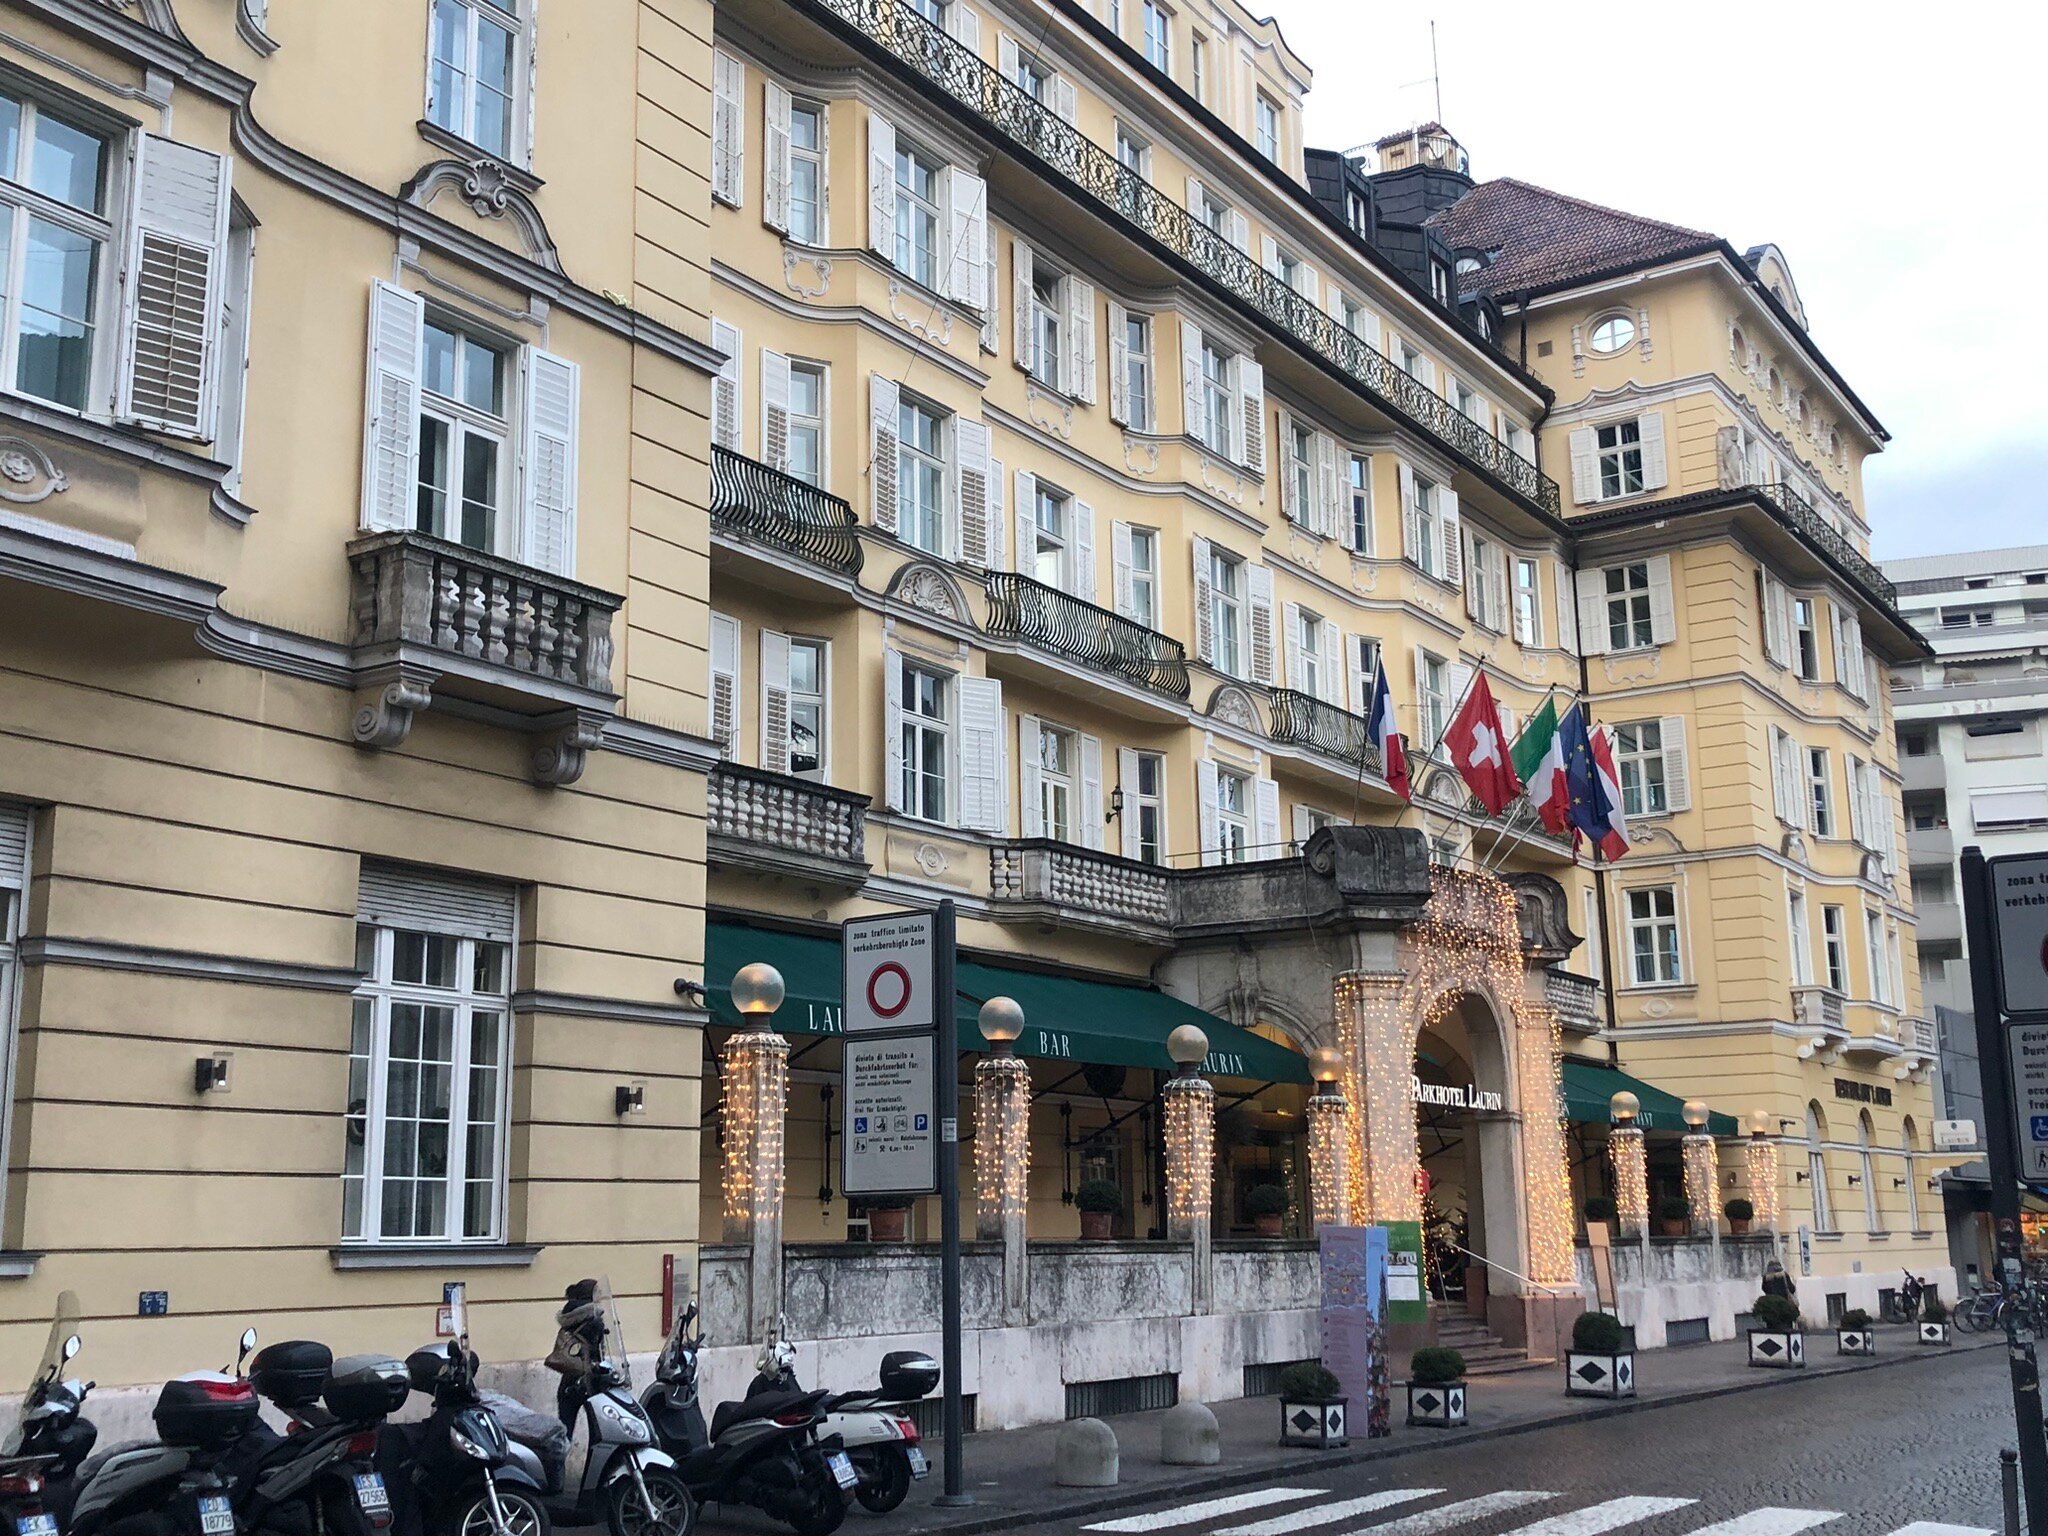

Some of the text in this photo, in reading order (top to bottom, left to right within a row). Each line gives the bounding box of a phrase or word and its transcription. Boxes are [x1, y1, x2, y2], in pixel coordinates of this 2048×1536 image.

[2007, 876, 2034, 886] zona
[853, 924, 925, 940] zona traffico limitato
[853, 937, 926, 953] verkehrsberuhigte Zone
[1040, 1031, 1071, 1057] BAR
